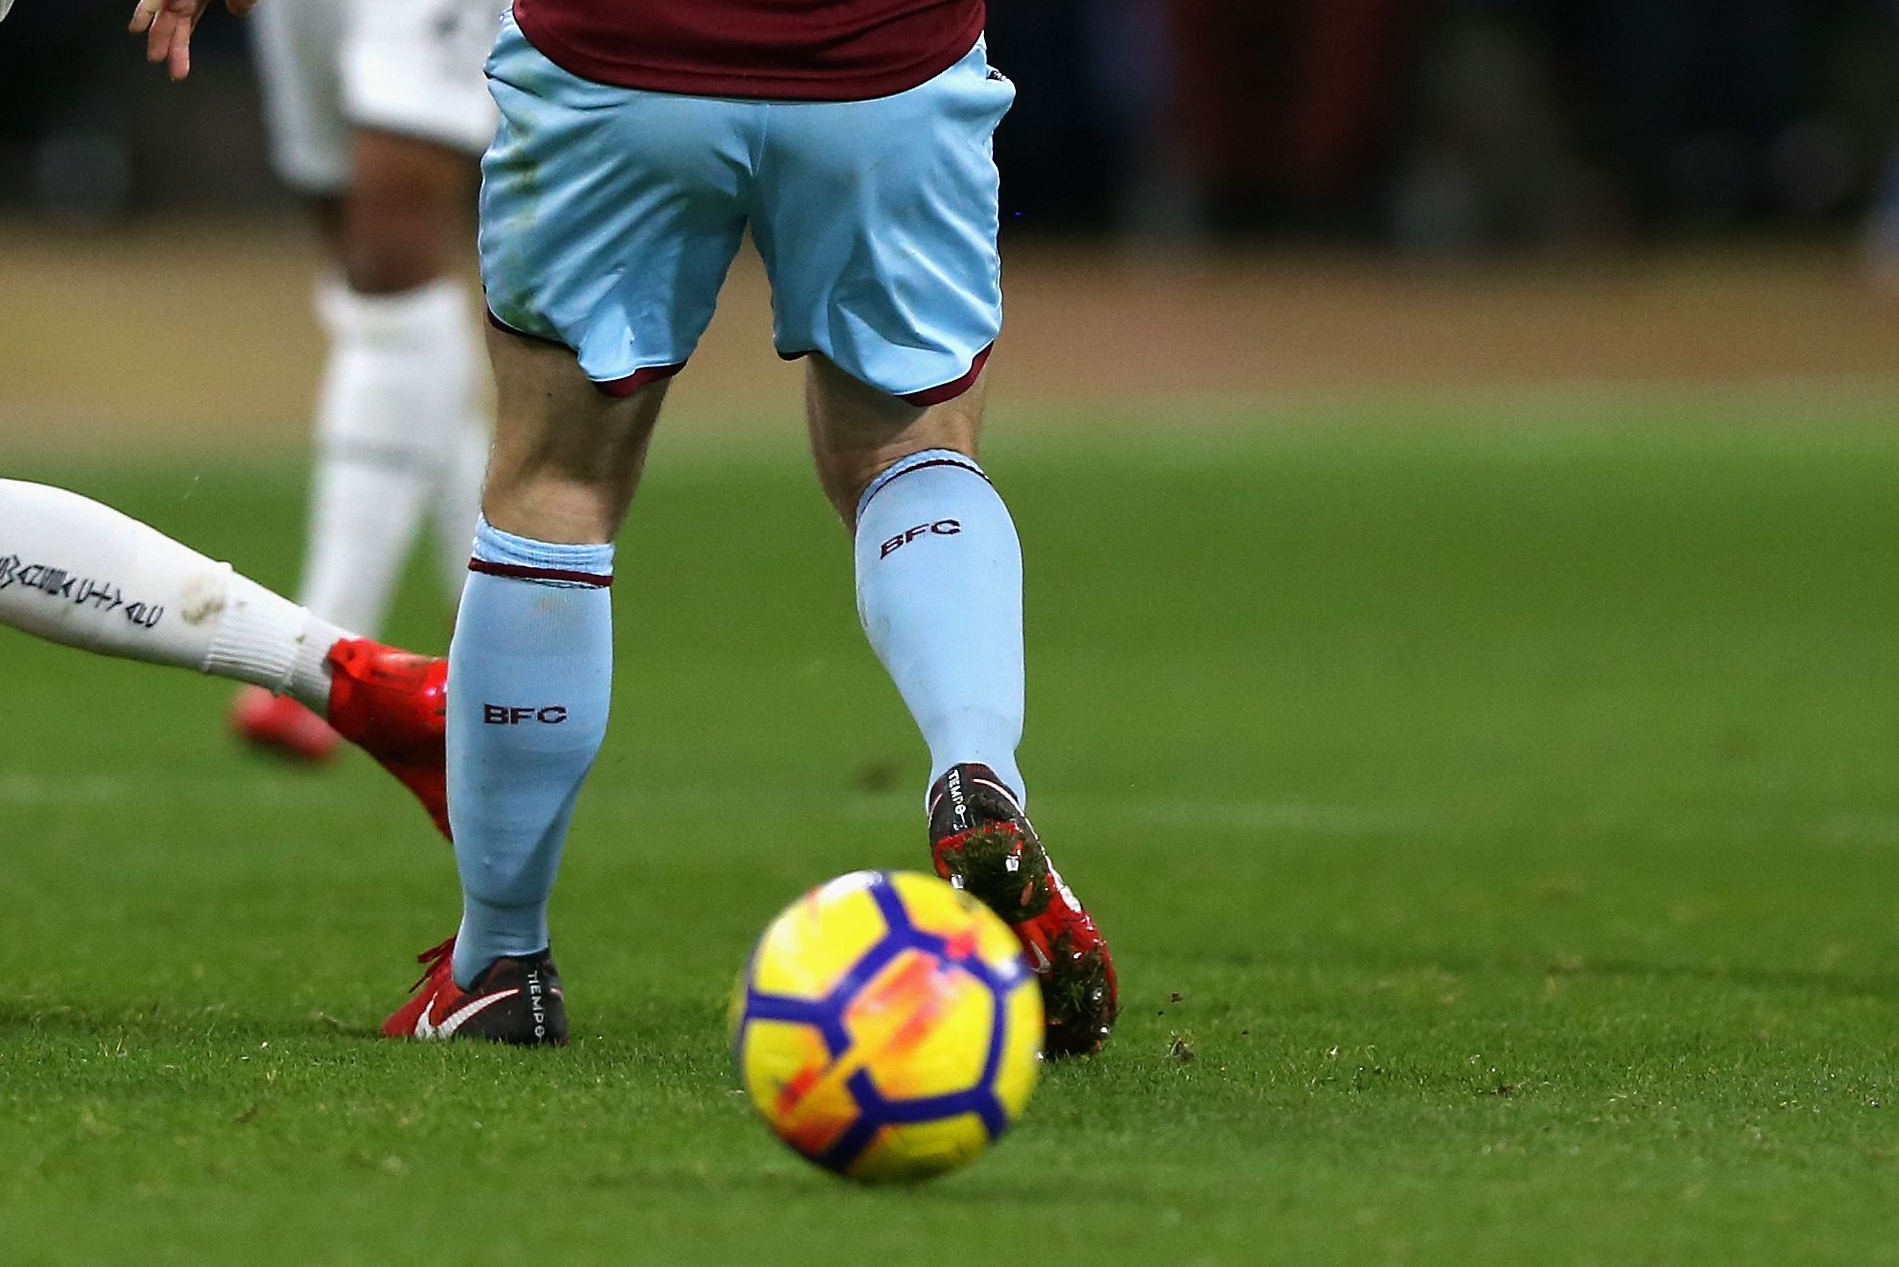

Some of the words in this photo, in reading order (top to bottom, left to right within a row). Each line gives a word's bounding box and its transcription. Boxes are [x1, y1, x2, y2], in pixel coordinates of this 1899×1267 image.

[879, 518, 961, 561] BFC
[483, 703, 568, 725] BFC
[527, 970, 546, 1037] TIEMPO
